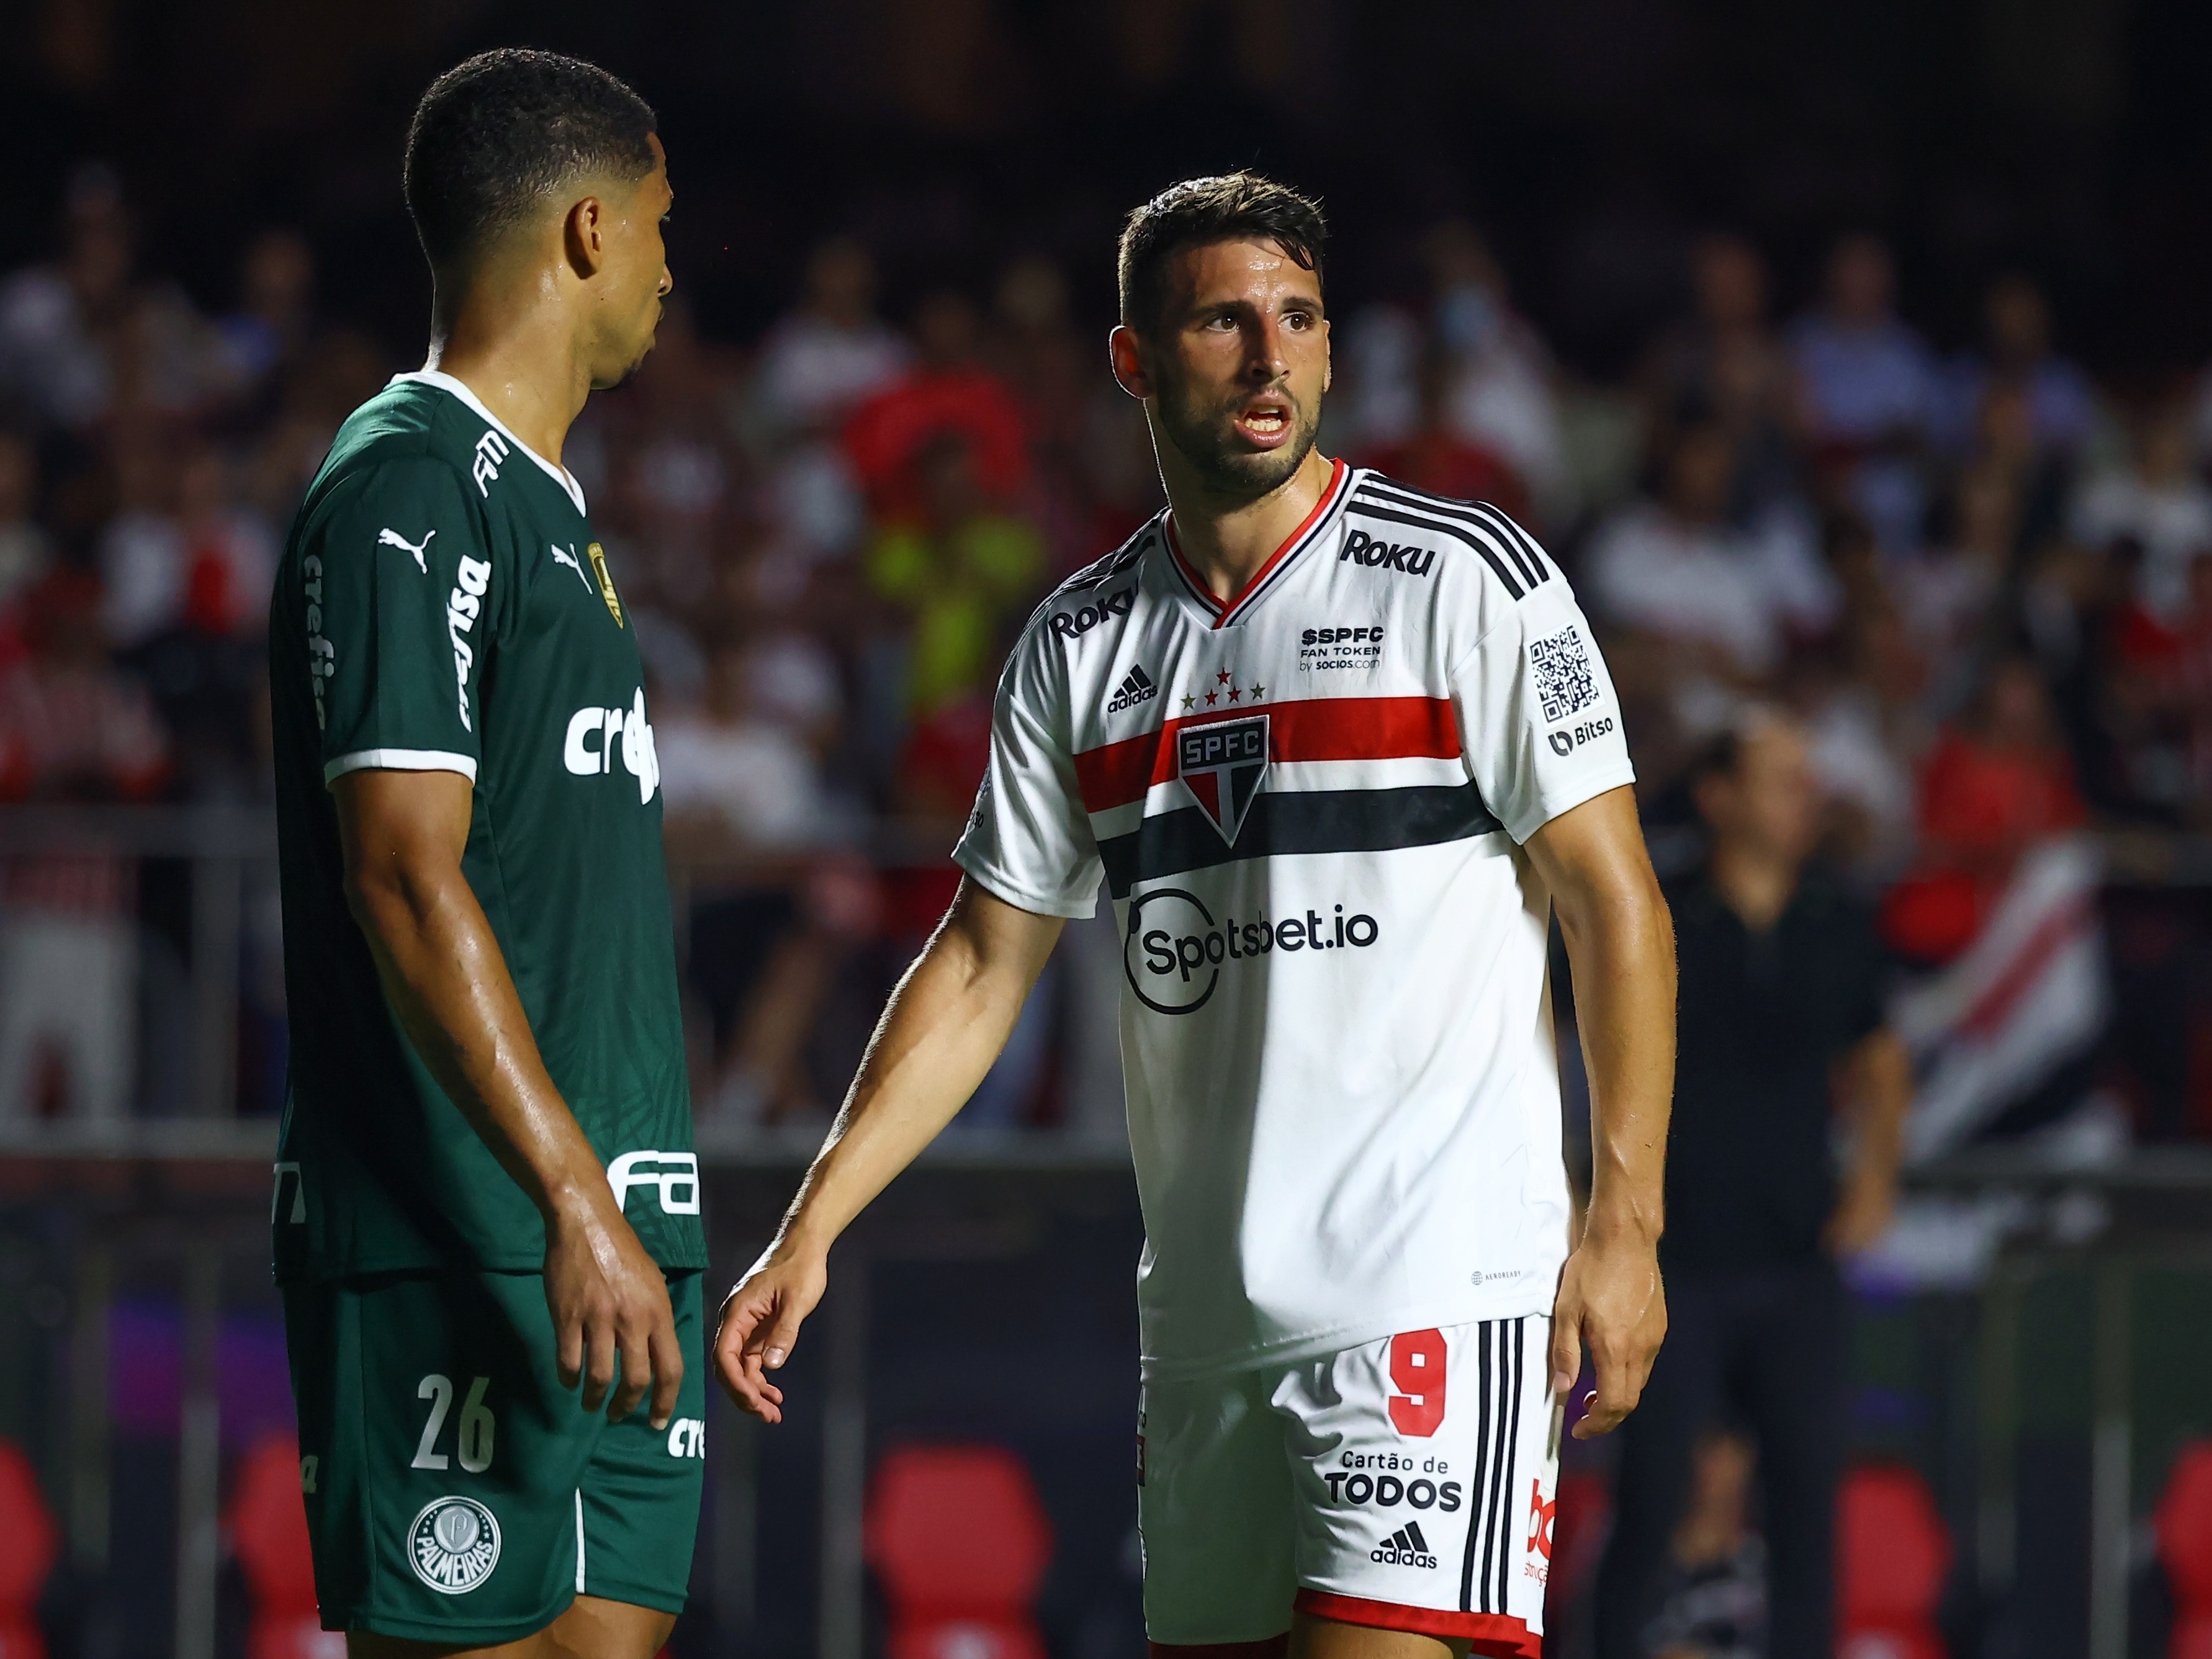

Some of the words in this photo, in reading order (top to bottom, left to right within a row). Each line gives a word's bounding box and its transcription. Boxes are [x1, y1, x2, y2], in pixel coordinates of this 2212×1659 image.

[1339, 529, 1436, 578] ROKU
[1302, 626, 1384, 646] $SPFC
[1300, 660, 1313, 672] by
[1301, 648, 1328, 658] FAN
[1333, 646, 1381, 656] TOKEN
[1107, 685, 1158, 713] adidas
[1575, 717, 1613, 746] Bitso
[1185, 730, 1259, 764] SPFC
[1143, 904, 1378, 982] Spotsbet.io
[1485, 1270, 1521, 1280] AEROREADY
[1388, 1328, 1447, 1437] 9
[410, 1374, 496, 1473] 26
[1342, 1450, 1414, 1472] Cartão
[1423, 1456, 1449, 1474] de
[1324, 1472, 1462, 1513] TODOS
[416, 1536, 493, 1586] PALMEIRAS
[1370, 1548, 1437, 1569] adidas
